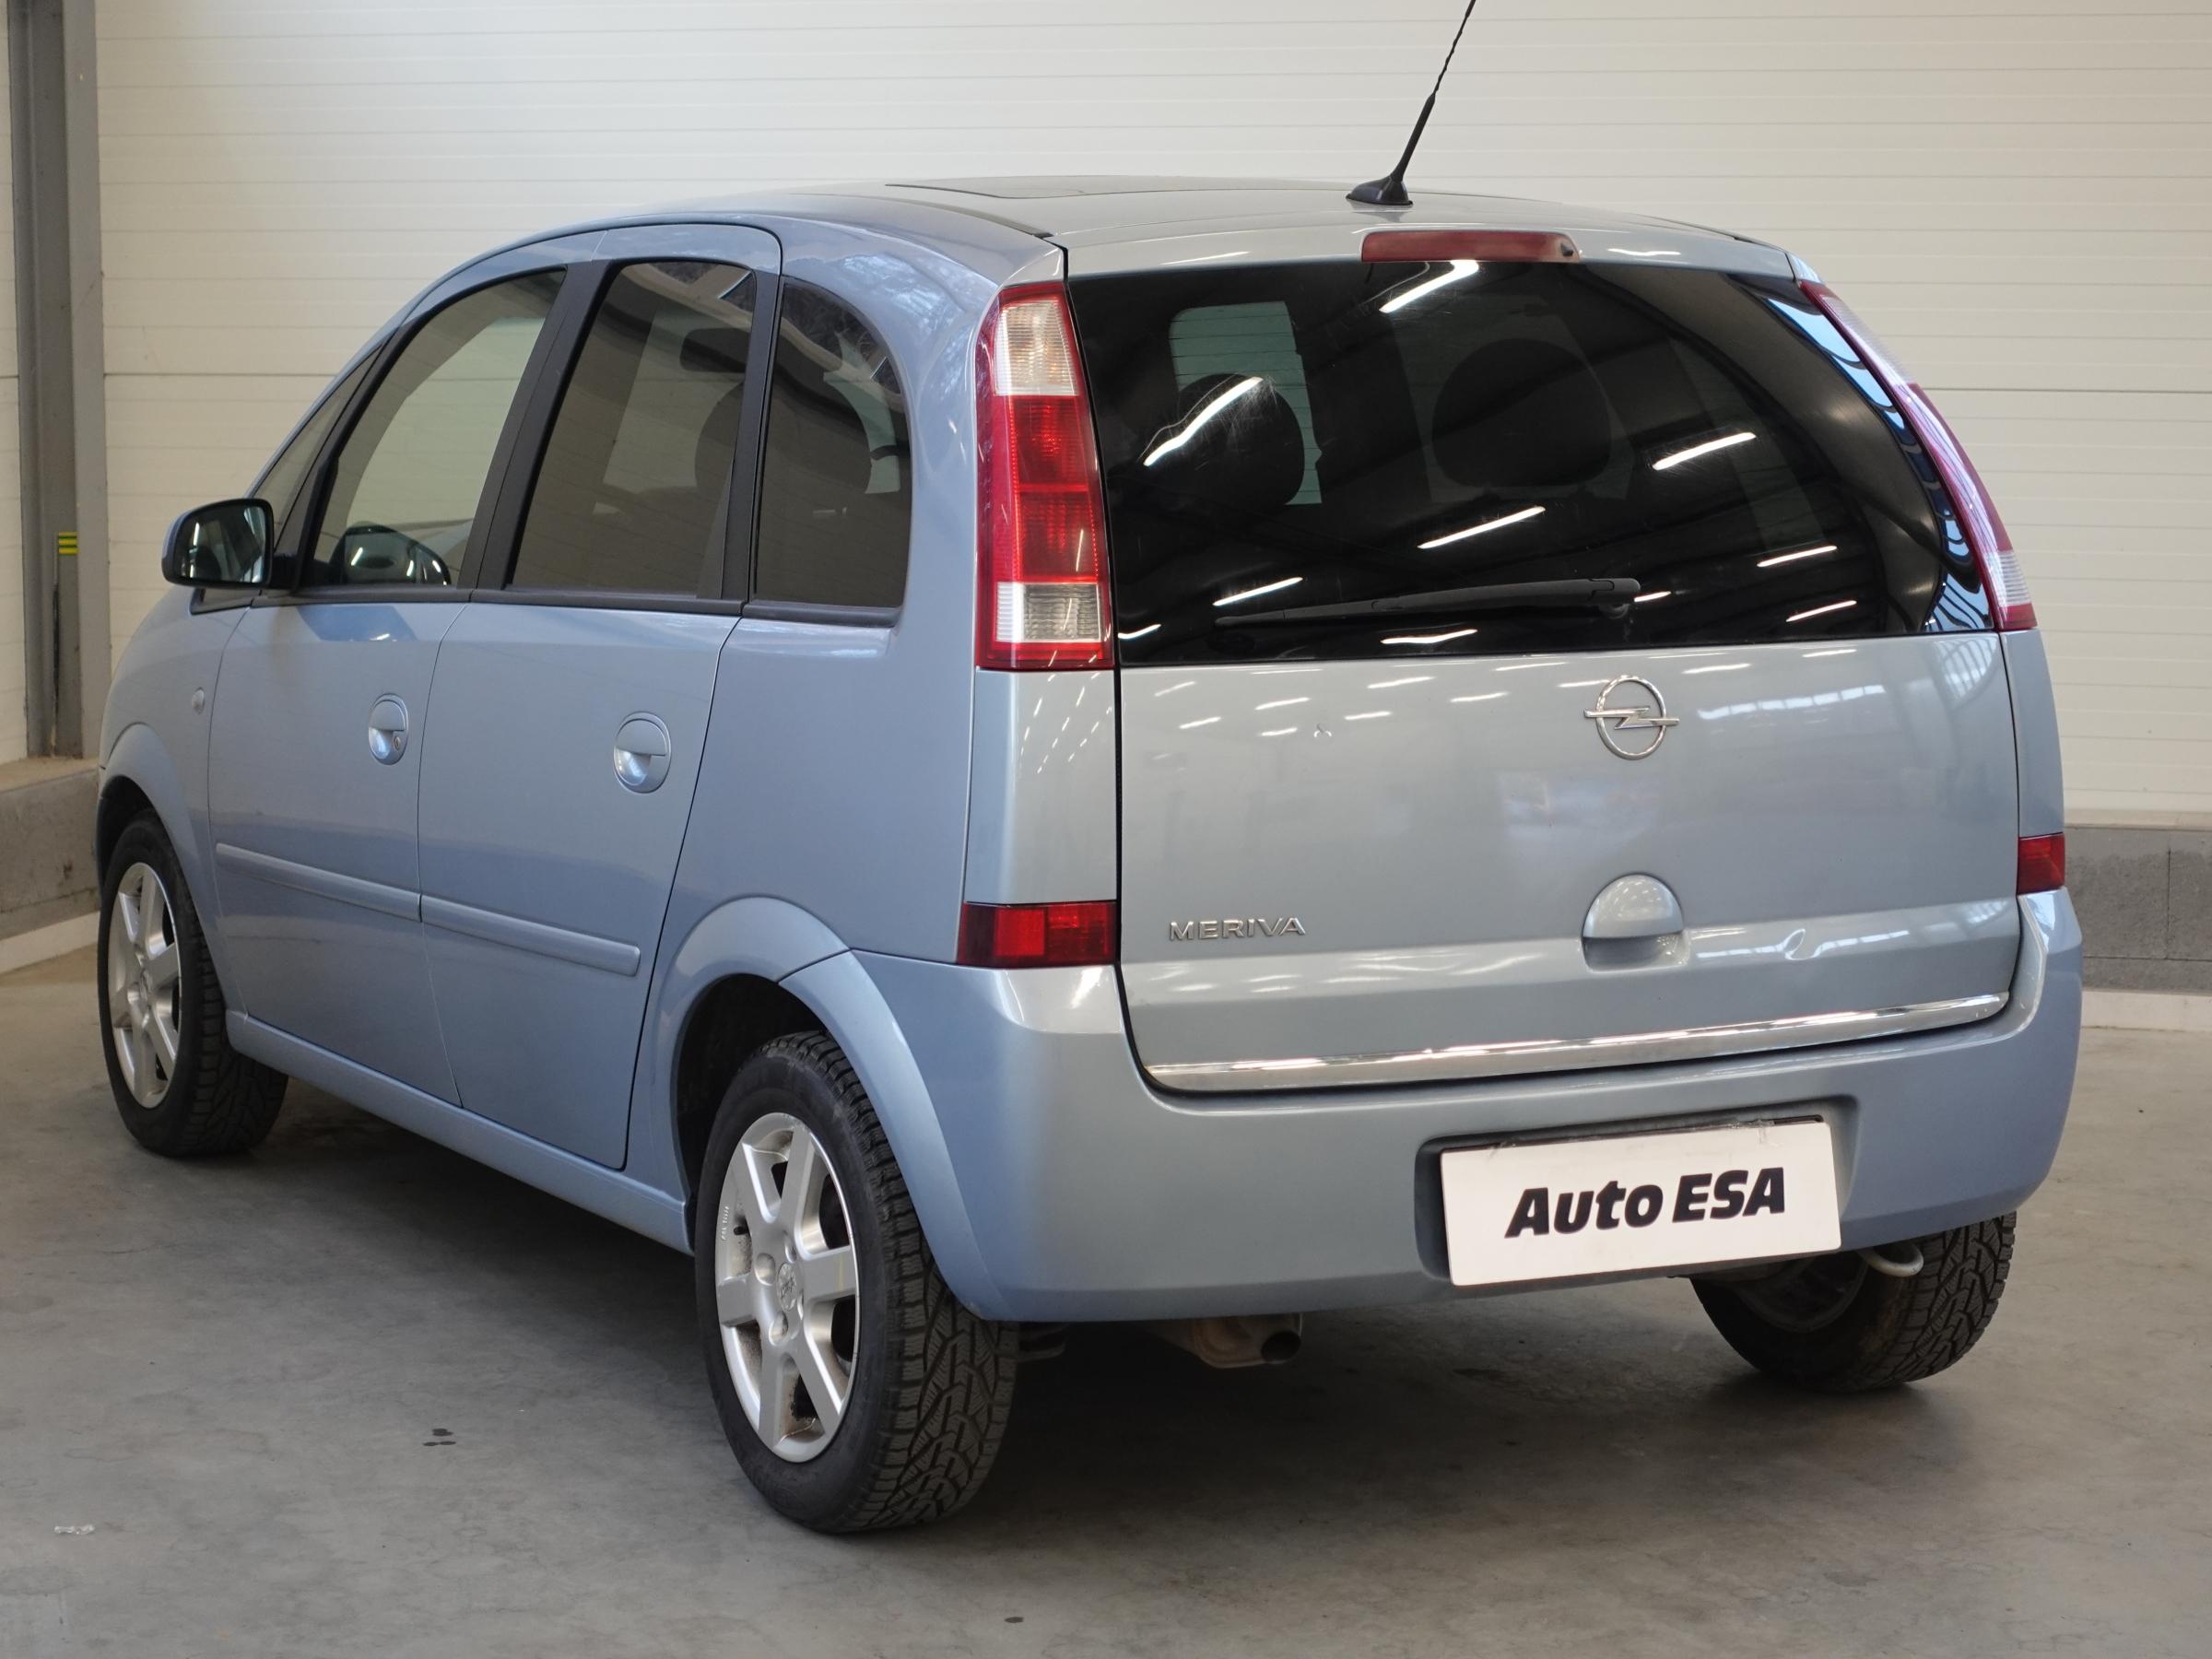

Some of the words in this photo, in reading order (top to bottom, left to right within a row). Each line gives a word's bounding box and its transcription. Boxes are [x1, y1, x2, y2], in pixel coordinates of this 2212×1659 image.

[1169, 917, 1306, 940] MERIVA
[1504, 1181, 1664, 1238] Auto
[1672, 1167, 1785, 1223] ESA
